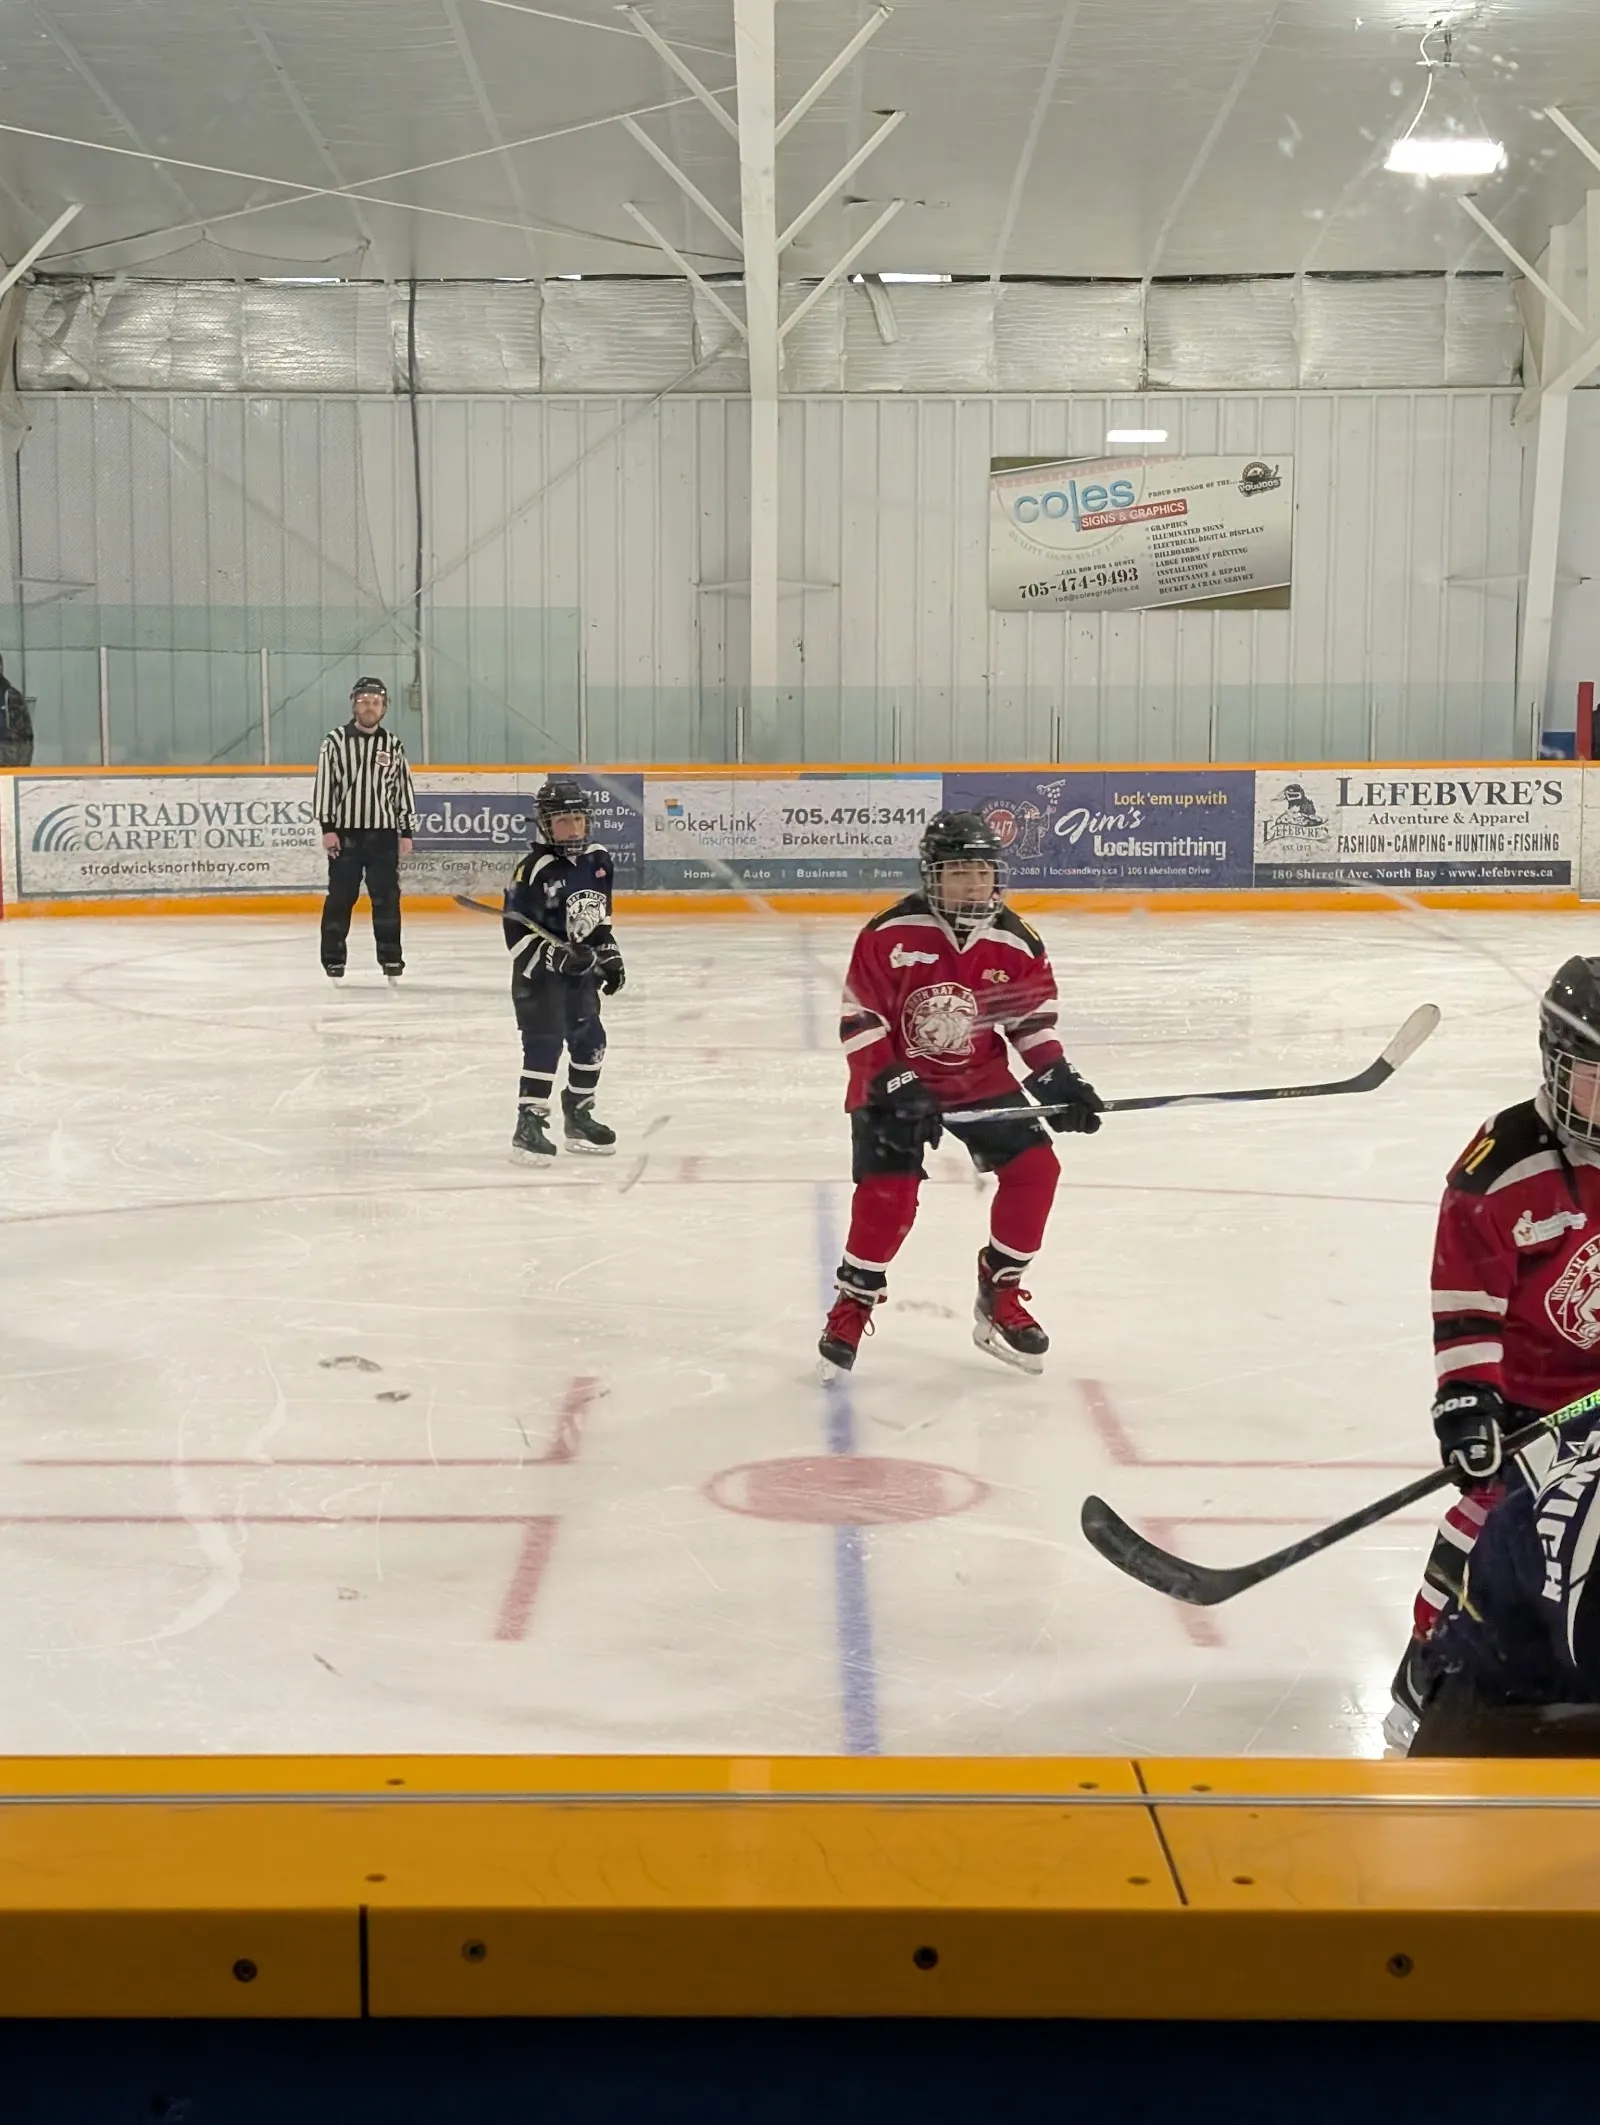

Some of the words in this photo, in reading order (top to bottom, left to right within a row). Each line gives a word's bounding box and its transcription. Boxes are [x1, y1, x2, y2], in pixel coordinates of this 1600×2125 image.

[1014, 480, 1135, 532] coles
[1082, 515, 1116, 527] SIGNS
[1120, 512, 1127, 521] &
[1130, 502, 1185, 519] GRAPHICS
[1150, 520, 1188, 532] GRAPHICS
[1152, 527, 1201, 541] ILLUMINATED
[1202, 523, 1225, 533] SIGNS
[1153, 537, 1197, 550] ELECTRICAL
[1198, 532, 1228, 543] DIGITAL
[1229, 525, 1265, 537] DISPLAYS
[1154, 546, 1200, 559] BILLBOARDS
[1156, 558, 1179, 568] LARGE
[1181, 552, 1210, 564] FORMAT
[1212, 546, 1248, 559] PRINTING
[1156, 563, 1209, 577] INSTALLATION
[1158, 571, 1210, 585] MAINTENANCE
[1219, 565, 1247, 576] REPAIR
[1018, 567, 1139, 599] 705-474-9493
[1159, 583, 1189, 595] BUCKET
[1198, 578, 1221, 589] CRANE
[1223, 573, 1255, 583] SERVICE
[1115, 792, 1144, 805] Lock
[1175, 795, 1194, 808] up
[1195, 791, 1228, 805] with
[1336, 777, 1563, 807] LEFEBVRE'S
[84, 800, 314, 828] STRADWICKS
[655, 813, 758, 832] BrokerLink
[782, 808, 927, 825] 705.476.3411
[1368, 813, 1449, 826] Adventure
[1454, 813, 1465, 825] &
[1469, 812, 1530, 827] Apparel
[271, 827, 316, 837] FLOOR
[604, 820, 625, 831] Bay
[1054, 806, 1145, 845] Jim's
[84, 828, 197, 851] CARPET
[205, 827, 265, 849] ONE
[699, 834, 758, 845] Insurance
[782, 833, 893, 846] BrokerLink.ca
[1094, 835, 1227, 860] Locksmithing
[1337, 835, 1385, 853] FASHION
[1394, 834, 1446, 852] CAMPING
[1455, 833, 1505, 852] HUNTING
[1514, 833, 1560, 852] FISHING
[80, 860, 270, 876] stradwicksnorthbay.com
[397, 861, 436, 872] ooms.
[441, 860, 476, 871] Great
[683, 869, 717, 879] Home
[743, 869, 771, 879] Auto
[796, 868, 848, 879] Business
[1127, 867, 1142, 875] 106
[1188, 866, 1211, 875] Drive
[1272, 868, 1293, 880] 180
[1347, 868, 1372, 879] Ave.
[1376, 868, 1411, 879] North
[1415, 868, 1438, 882] Bay
[1448, 867, 1554, 879] www.lefebvres.ca
[932, 985, 955, 997] BAY
[1550, 1256, 1586, 1302] NORTH
[1584, 1237, 1600, 1258] B
